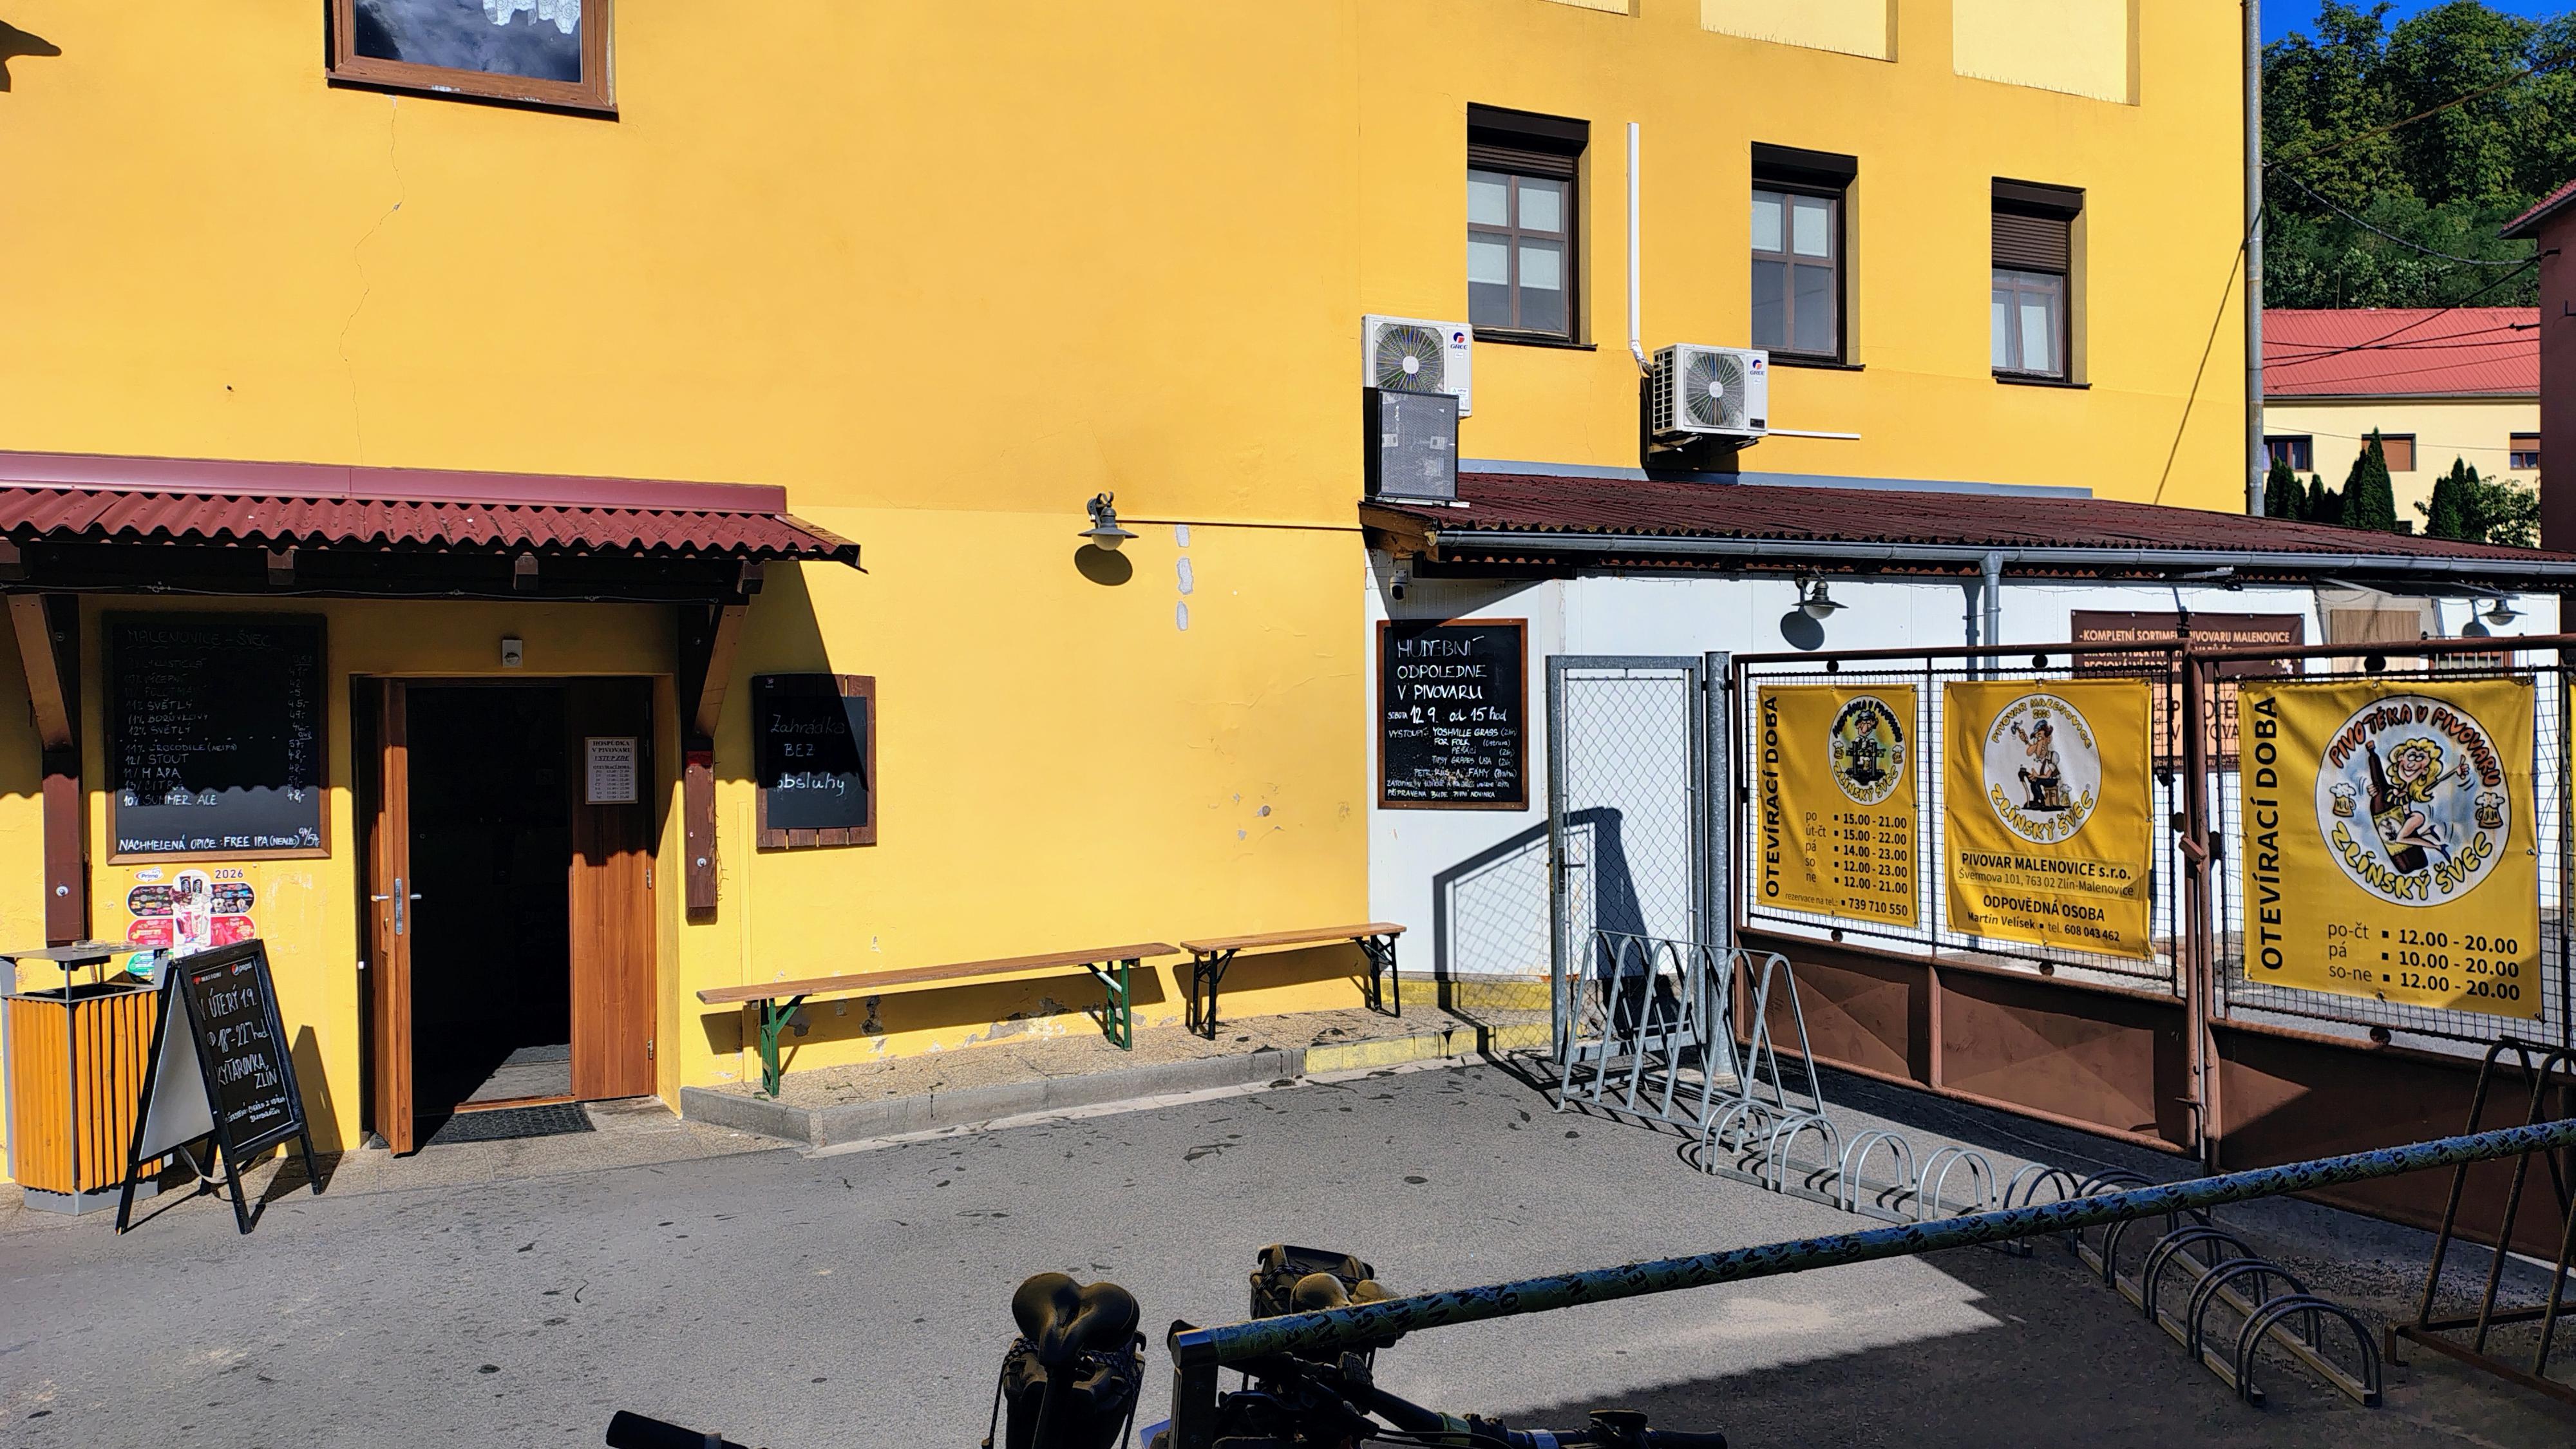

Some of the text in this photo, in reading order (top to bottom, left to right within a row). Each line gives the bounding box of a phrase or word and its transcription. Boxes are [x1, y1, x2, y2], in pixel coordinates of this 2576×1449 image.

[1397, 635, 1484, 658] HUDEBNÍ
[2233, 632, 2290, 643] MALENOVICE
[1397, 665, 1487, 679] ODPOLEDNE
[1397, 684, 1483, 700] V PIVOVARU
[771, 713, 845, 734] Zahrádka
[1449, 709, 1466, 722] od
[1471, 707, 1487, 722] 15
[1489, 706, 1507, 722] hod
[1991, 702, 2028, 744] PIVOVAR
[1434, 737, 1449, 746] FOR
[1473, 728, 1499, 737] GRASS
[784, 743, 815, 757] BEZ
[2329, 703, 2412, 769] PIVOTÉKA
[2431, 706, 2502, 787] PIVOVARU
[148, 752, 189, 764] STOUT
[156, 766, 182, 779] APA
[1833, 761, 1899, 802] ZLÍNSKÝ ŠVEC
[777, 772, 845, 797] obsluhy
[196, 794, 218, 806] ALE
[1762, 697, 1779, 897] OTEVÍRACÍ DOBA
[1806, 811, 1907, 829] po 15.00 21.00
[1991, 783, 2094, 840] ZLÍNSKÝ ŠVEC
[119, 834, 185, 851] NACHMELENÁ
[191, 838, 216, 850] OPICE
[223, 836, 250, 848] FREE
[254, 836, 269, 847] IPA
[1806, 824, 1907, 845] út-čt 15.00 22.00
[2250, 697, 2283, 971] OTEVÍRACÍ DOBA
[1805, 839, 1908, 862] pá 14.00 23.00
[2332, 821, 2493, 901] ZLÍNSKÝ ŠVEC
[215, 869, 243, 879] 2026
[1805, 858, 1908, 878] so 12.00 23.00
[1962, 853, 2131, 880] PIVOVAR MALENOVICE s.r.o.
[1806, 873, 1908, 894] ne 12.00 21.00
[1958, 867, 2134, 896] Švermova 101, 763 02 Zlín-Malenovice
[1785, 893, 1815, 903] rezervace
[1848, 898, 1866, 911] 739
[1869, 900, 1886, 913] 710
[1889, 904, 1908, 916] 550
[1983, 895, 2105, 922] ODPOVĚDNÁ OSOBA
[1967, 911, 2120, 942] Martin Velísek tel. 608 043 462
[2328, 922, 2518, 954] po-čt 12.00 20.00
[239, 961, 252, 973] pepsi
[2329, 941, 2519, 978] pá 10.00 20.00
[2329, 965, 2520, 1001] so-ne 12.00 20.00
[198, 998, 206, 1021] V
[208, 984, 238, 1018] ÚTERÝ
[254, 1065, 278, 1090] ZLÍN
